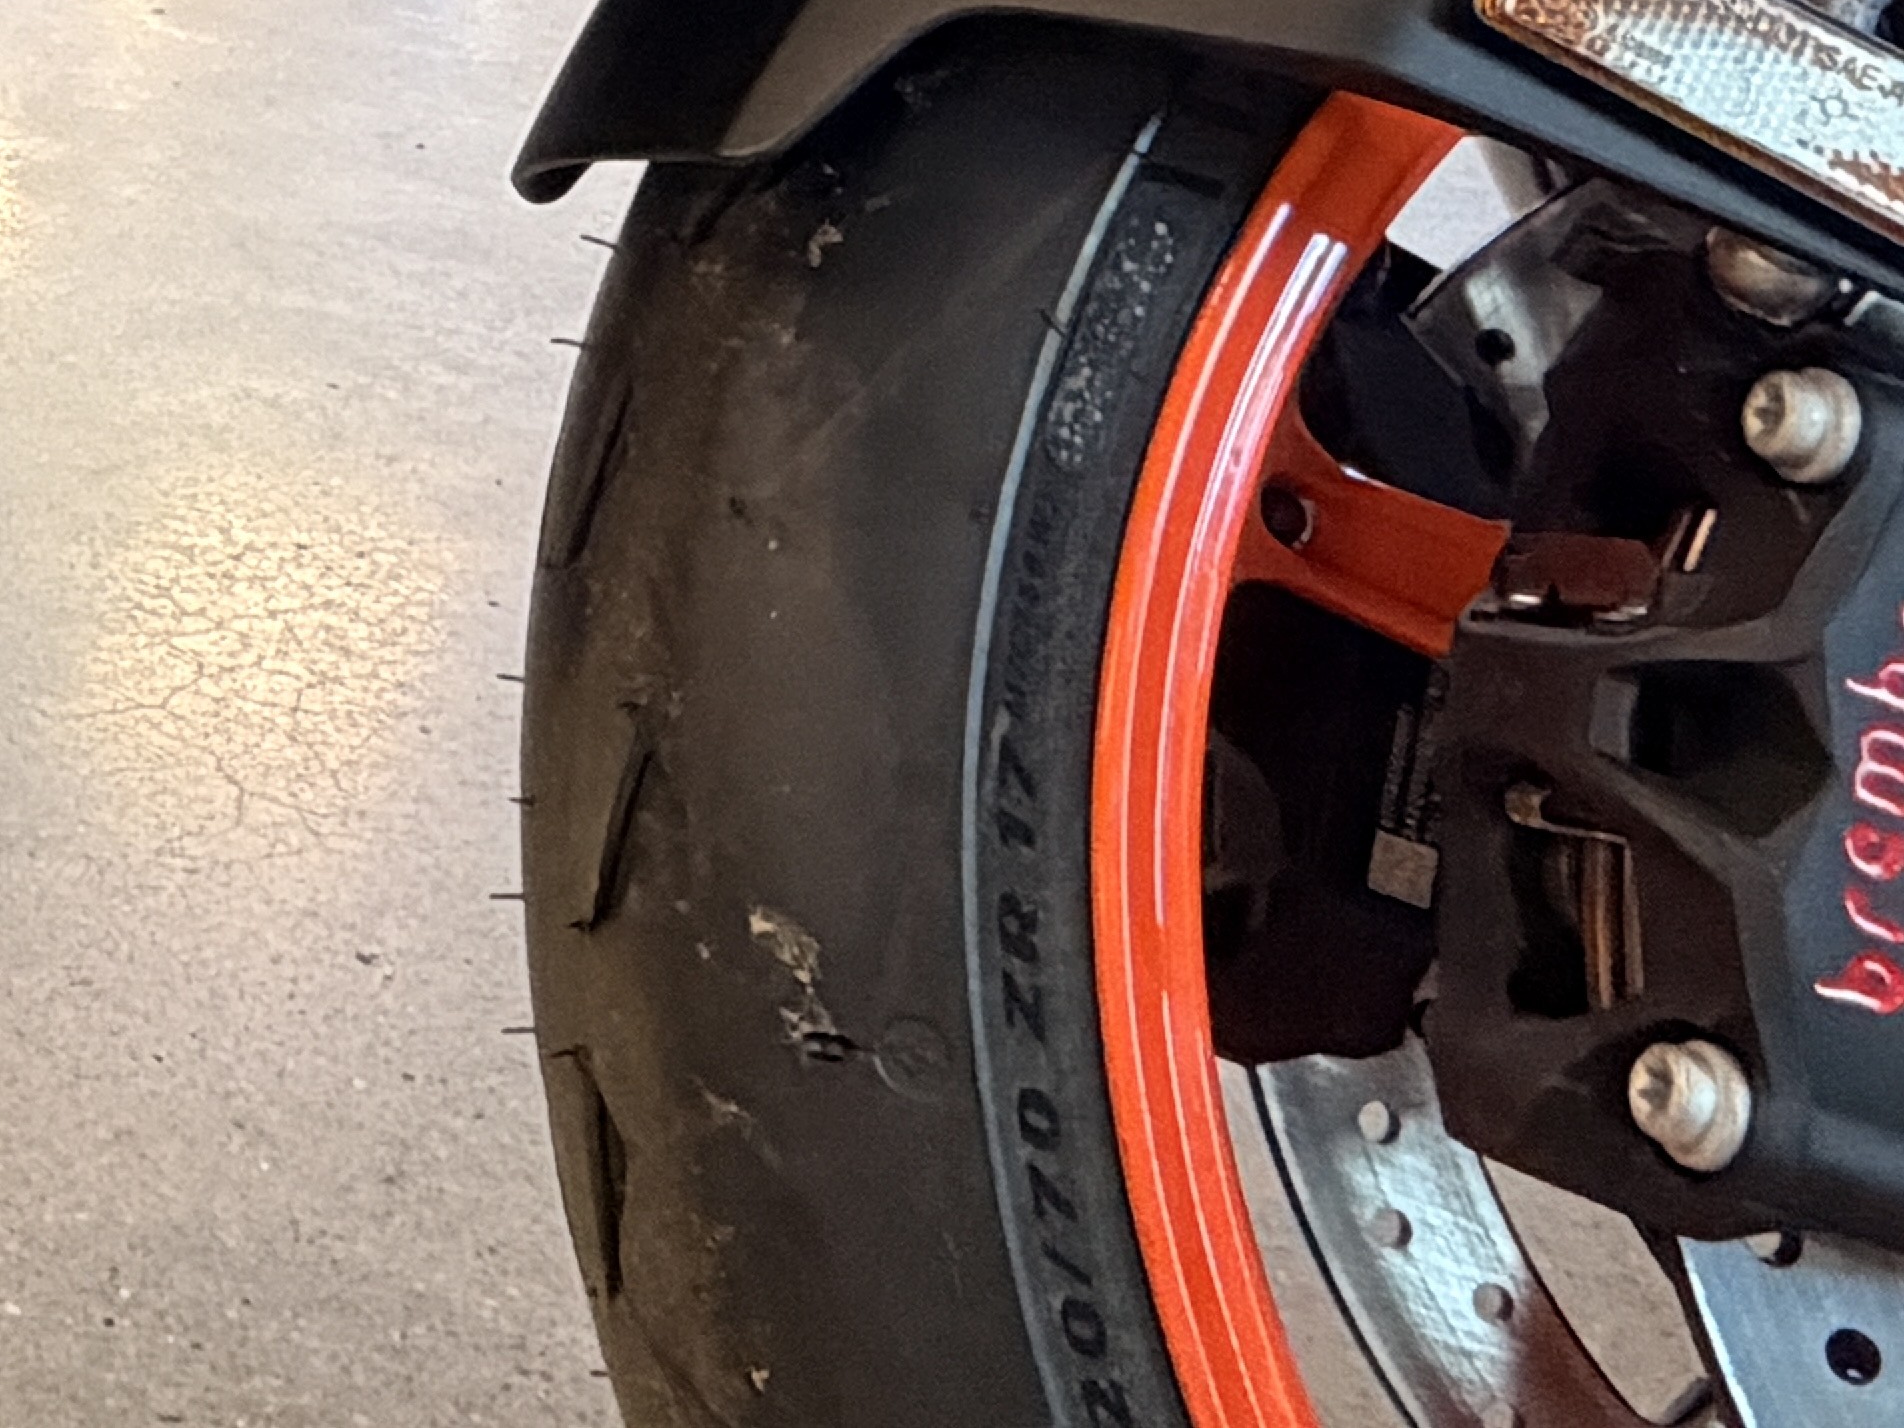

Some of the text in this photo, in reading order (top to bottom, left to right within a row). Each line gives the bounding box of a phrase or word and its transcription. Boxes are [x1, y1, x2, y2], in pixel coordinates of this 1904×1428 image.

[991, 732, 1038, 853] 17
[1813, 602, 1904, 1014] bremb
[994, 891, 1046, 1042] ZR
